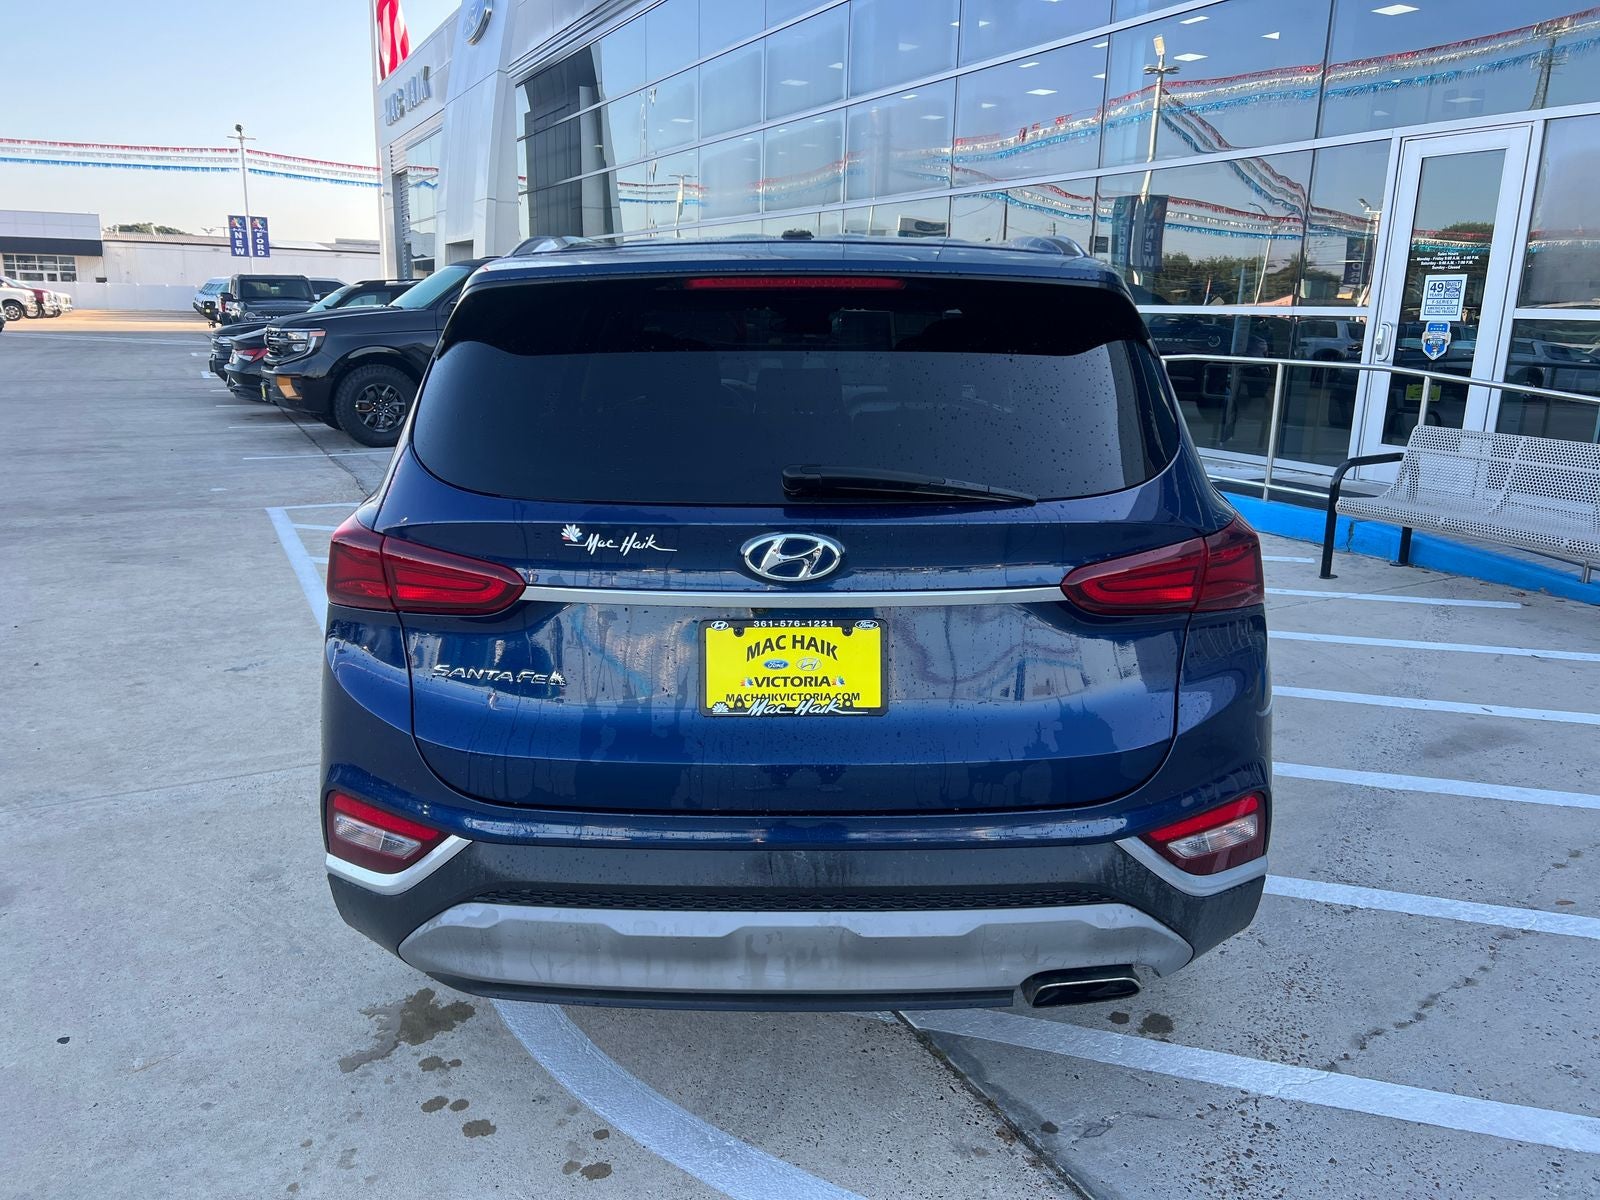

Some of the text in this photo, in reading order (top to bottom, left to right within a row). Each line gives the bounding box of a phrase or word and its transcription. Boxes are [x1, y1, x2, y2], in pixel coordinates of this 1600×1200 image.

[234, 231, 245, 256] NEW
[256, 232, 266, 256] FORD
[1430, 283, 1444, 292] 49
[584, 532, 678, 556] Mac Haik
[753, 620, 834, 628] 361-576-1221
[746, 634, 838, 662] MAC HAIK
[766, 660, 787, 669] Ford
[753, 676, 832, 688] VICTORIA
[725, 692, 861, 702] MACHAIKVICTORIA.COM
[746, 697, 867, 717] Mac Haik
